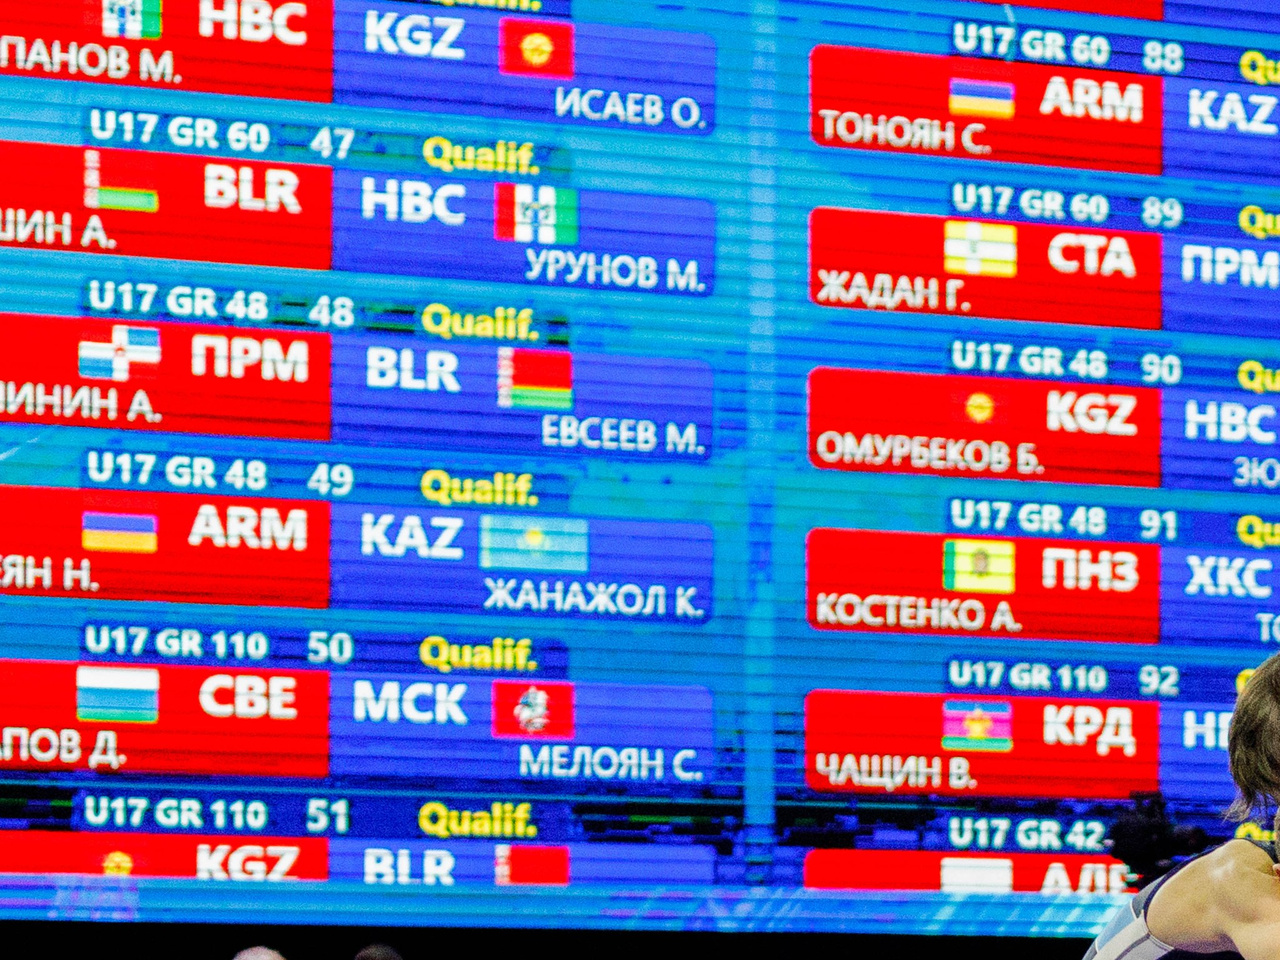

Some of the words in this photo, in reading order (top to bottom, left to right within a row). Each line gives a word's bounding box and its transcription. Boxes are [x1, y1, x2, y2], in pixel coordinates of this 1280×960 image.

[365, 10, 465, 60] KGZ
[953, 22, 1016, 54] U17
[1021, 30, 1067, 62] GR
[1070, 35, 1111, 66] 60
[139, 48, 182, 84] М.
[1142, 40, 1184, 74] 88
[555, 87, 665, 125] ИСАЕВ
[671, 98, 706, 129] О.
[1039, 76, 1144, 123] ARM
[1189, 89, 1279, 135] KAZ
[90, 109, 159, 142] U17
[168, 117, 219, 149] GR
[227, 122, 270, 153] 60
[310, 127, 355, 159] 47
[818, 109, 955, 152] ТОНОЯН
[960, 122, 992, 155] С.
[423, 136, 540, 175] Qualif.
[205, 163, 302, 214] BLR
[953, 183, 1014, 214] U17
[1020, 189, 1066, 220] GR
[1070, 193, 1110, 222] 60
[81, 214, 117, 249] А.
[1142, 196, 1183, 228] 89
[526, 248, 659, 289] УРУНОВ
[667, 258, 706, 293] М.
[1047, 232, 1136, 278] СТА
[1182, 244, 1280, 288] ПРМ
[90, 280, 157, 312] U17
[166, 286, 218, 317] GR
[225, 291, 269, 320] 48
[817, 269, 939, 310] ЖАДАН
[945, 278, 972, 312] Г.
[309, 295, 355, 327] 48
[421, 303, 540, 341] Qualif.
[191, 334, 309, 382] ПРМ
[366, 346, 461, 392] BLR
[952, 340, 1014, 372] U17
[1019, 346, 1064, 377] GR
[1069, 350, 1108, 379] 48
[1140, 354, 1182, 385] 90
[0, 381, 118, 421] ИНИН
[126, 389, 163, 423] А.
[1046, 391, 1138, 437] KGZ
[542, 414, 657, 452] ЕВСЕЕВ
[666, 422, 706, 455] М.
[816, 430, 1010, 473] ОМУРБЕКОВ
[1016, 442, 1045, 475] Б.
[88, 451, 157, 484] U17
[165, 456, 217, 488] GR
[225, 460, 268, 490] 48
[308, 463, 355, 496] 49
[420, 469, 539, 507] Qualif.
[188, 504, 308, 551] ARM
[361, 513, 464, 560] KAZ
[951, 499, 1011, 529] U17
[1018, 503, 1063, 534] GR
[1069, 507, 1107, 535] 48
[1140, 510, 1178, 541] 91
[0, 554, 52, 589] ЯН
[63, 557, 100, 592] Н.
[1042, 548, 1139, 592] ПНЗ
[1185, 555, 1273, 599] ХКС
[483, 578, 666, 616] ЖАНАЖОЛ
[675, 586, 705, 618] К.
[816, 593, 986, 631] КОСТЕНКО
[990, 601, 1023, 633] А.
[85, 625, 149, 656] U17
[155, 630, 205, 657] GR
[212, 631, 269, 659] 110
[307, 631, 354, 664] 50
[419, 635, 538, 673] Qualif.
[950, 661, 1004, 689] U17
[1009, 663, 1051, 690] GR
[1057, 665, 1108, 692] 110
[1139, 665, 1181, 697] 92
[199, 674, 297, 719] СВЕ
[353, 680, 469, 725] МСК
[0, 727, 82, 763] ПОВ
[88, 730, 127, 770] Д.
[1043, 704, 1136, 757] КРД
[519, 745, 665, 781] МЕЛОЯН
[672, 749, 704, 782] С.
[815, 753, 942, 792] ЧАЩИН
[949, 756, 978, 789] В.
[84, 796, 149, 827] U17
[155, 800, 204, 828] GR
[211, 800, 268, 829] 110
[306, 799, 350, 833] 51
[418, 801, 538, 838] Qualif.
[950, 817, 1010, 849] U17
[1015, 819, 1061, 850] GR
[1065, 821, 1106, 850] 42
[196, 844, 300, 882] KGZ
[364, 848, 456, 886] BLR
